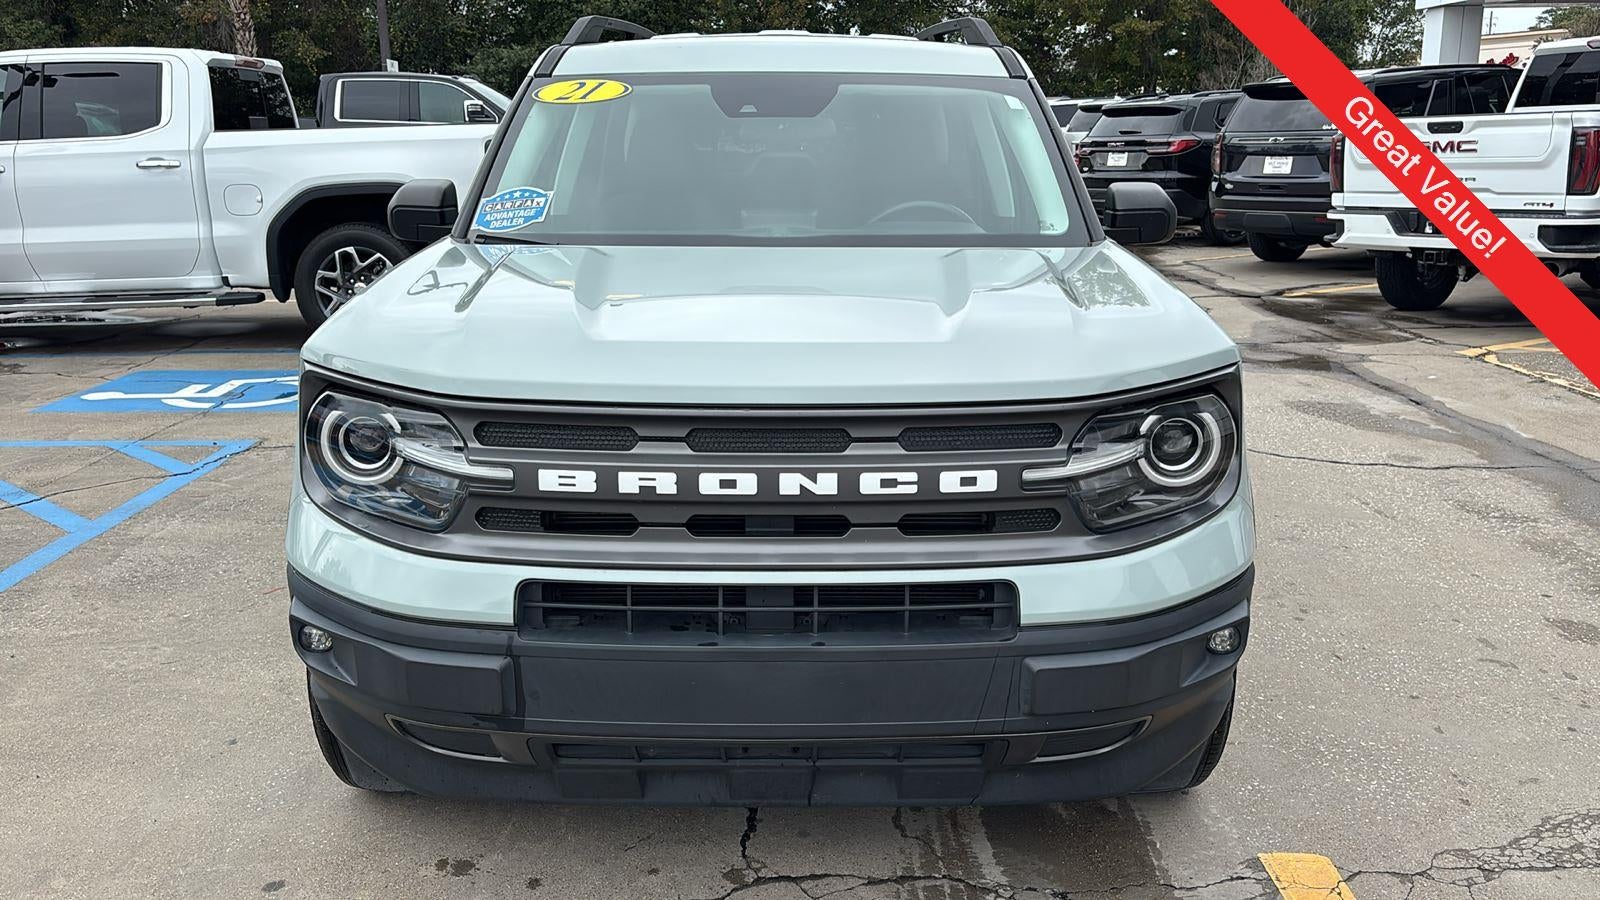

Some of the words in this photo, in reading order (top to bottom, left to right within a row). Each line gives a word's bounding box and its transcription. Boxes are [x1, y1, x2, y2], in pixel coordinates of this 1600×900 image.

[551, 81, 607, 101] 21
[484, 198, 545, 212] CARFAX
[484, 208, 537, 222] ADVANTAGE
[489, 217, 525, 229] DEALER
[537, 468, 998, 496] BRONCO
